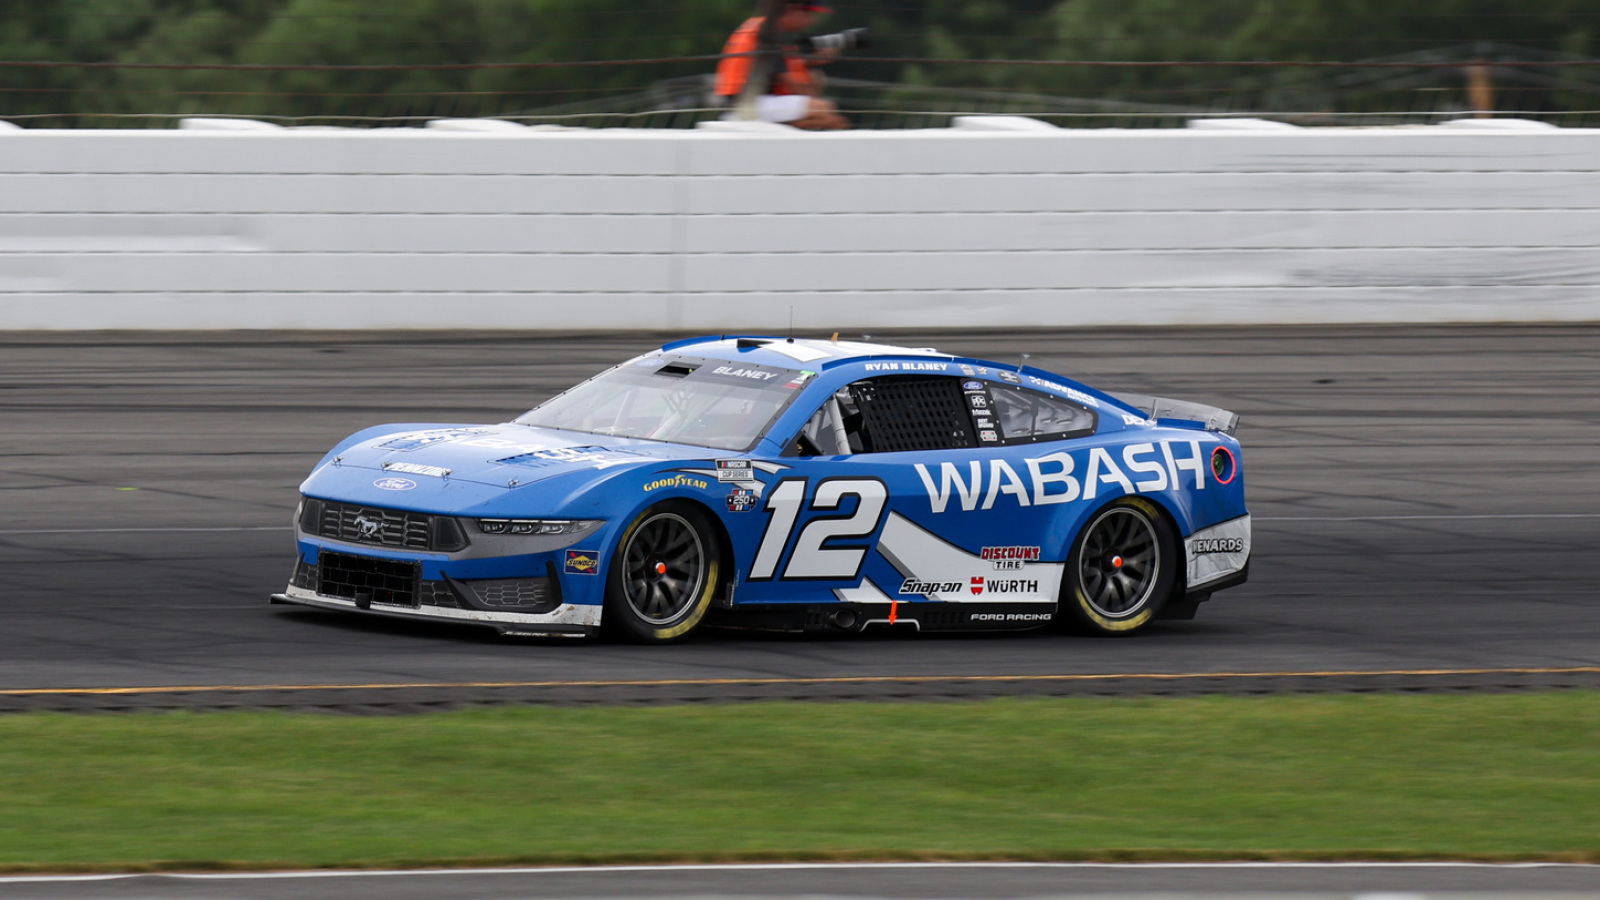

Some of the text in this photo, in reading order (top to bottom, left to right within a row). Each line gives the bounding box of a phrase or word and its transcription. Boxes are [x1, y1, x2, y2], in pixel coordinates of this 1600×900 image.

[864, 362, 948, 371] RYAN BLANEY
[712, 365, 778, 381] BLANEY
[727, 460, 747, 468] NASCAR
[732, 470, 749, 478] SERIES
[914, 439, 1206, 513] WABASH
[643, 474, 708, 492] GOODYEAR
[733, 495, 750, 505] 250
[748, 477, 888, 581] 12
[981, 545, 1041, 560] DISCOUNT
[566, 558, 598, 567] SUNOCO
[996, 561, 1021, 569] TIRE
[899, 578, 963, 595] Snap-on
[1006, 613, 1052, 621] RACING
